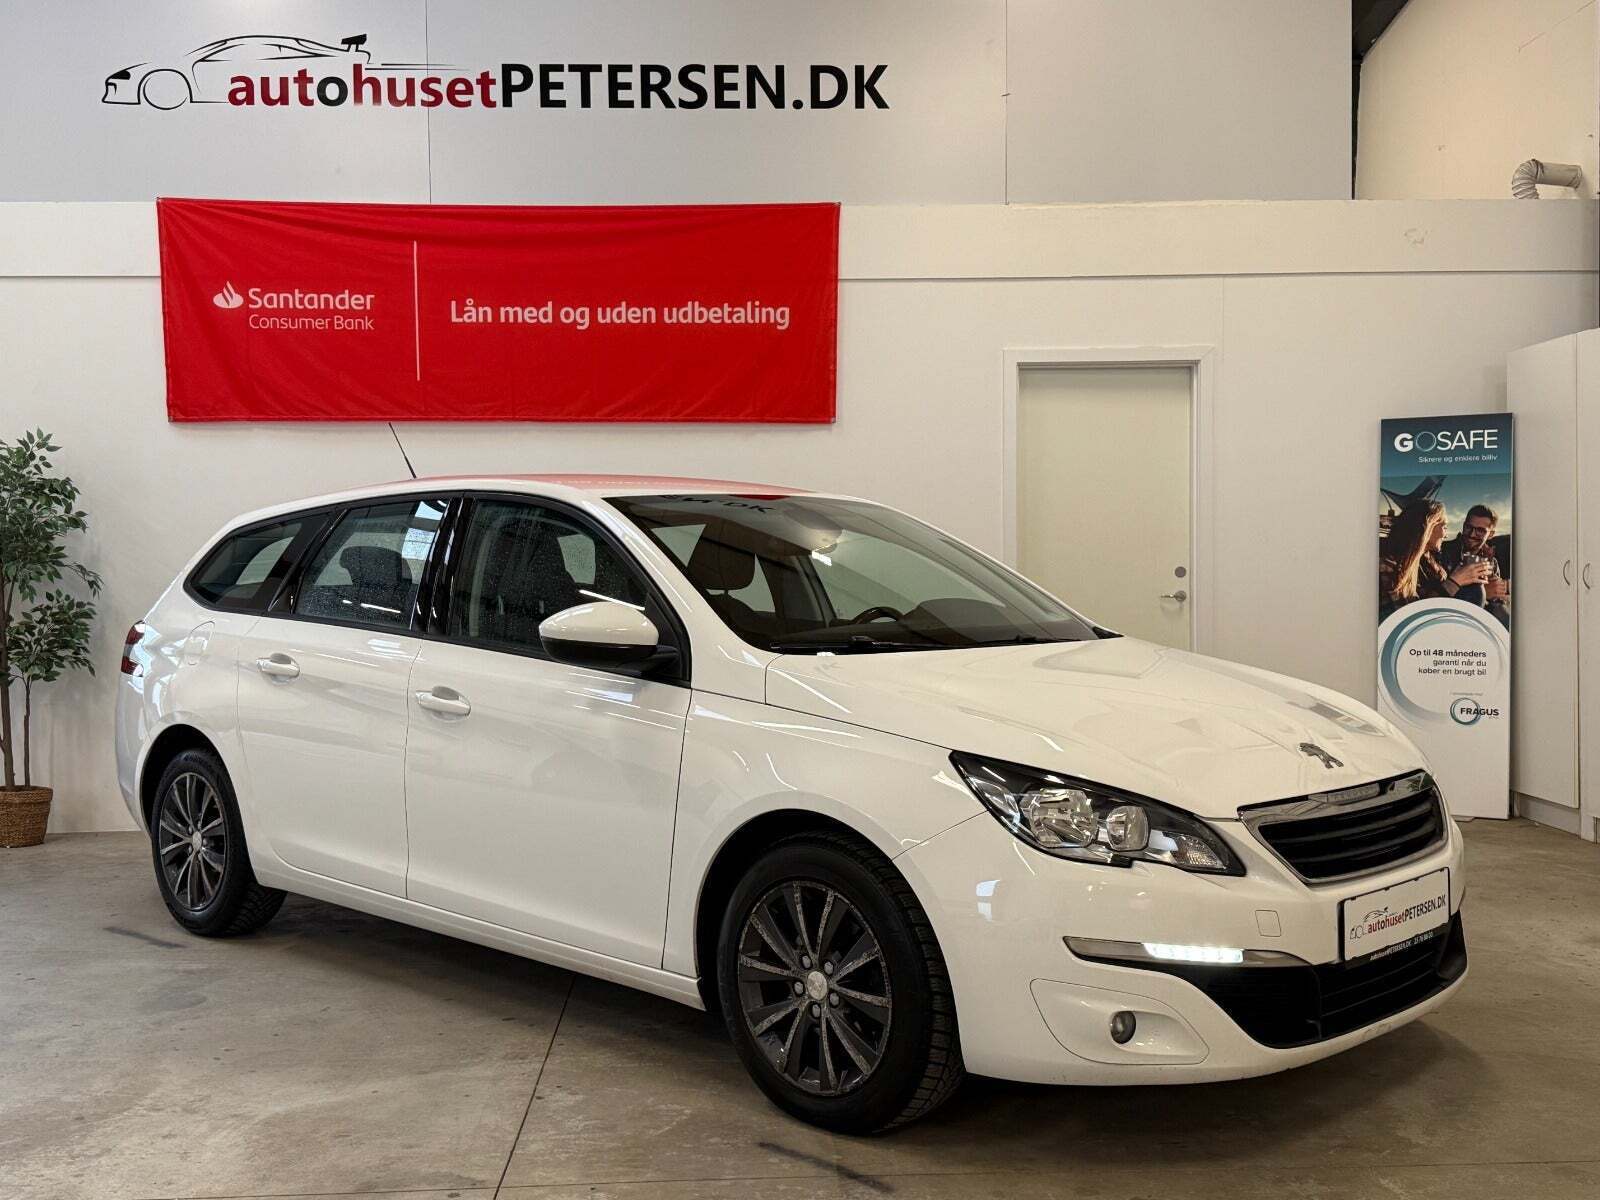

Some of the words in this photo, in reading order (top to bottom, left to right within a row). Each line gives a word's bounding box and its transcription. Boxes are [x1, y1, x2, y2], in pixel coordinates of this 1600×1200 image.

[228, 63, 890, 109] autohusetPETERSEN.DK
[248, 287, 375, 310] Santander
[249, 314, 331, 330] Consumer
[334, 315, 374, 331] Bank
[450, 298, 492, 323] Lån
[499, 300, 553, 324] med
[559, 305, 590, 330] og
[597, 301, 656, 324] uden
[663, 300, 790, 330] udbetaling
[1394, 429, 1498, 452] GOSAFE
[1409, 648, 1421, 657] Op
[1445, 649, 1487, 658] måneders
[1433, 659, 1460, 667] garanti
[1461, 659, 1474, 667] når
[1454, 668, 1475, 676] brugt
[1460, 707, 1500, 716] FRAGUS
